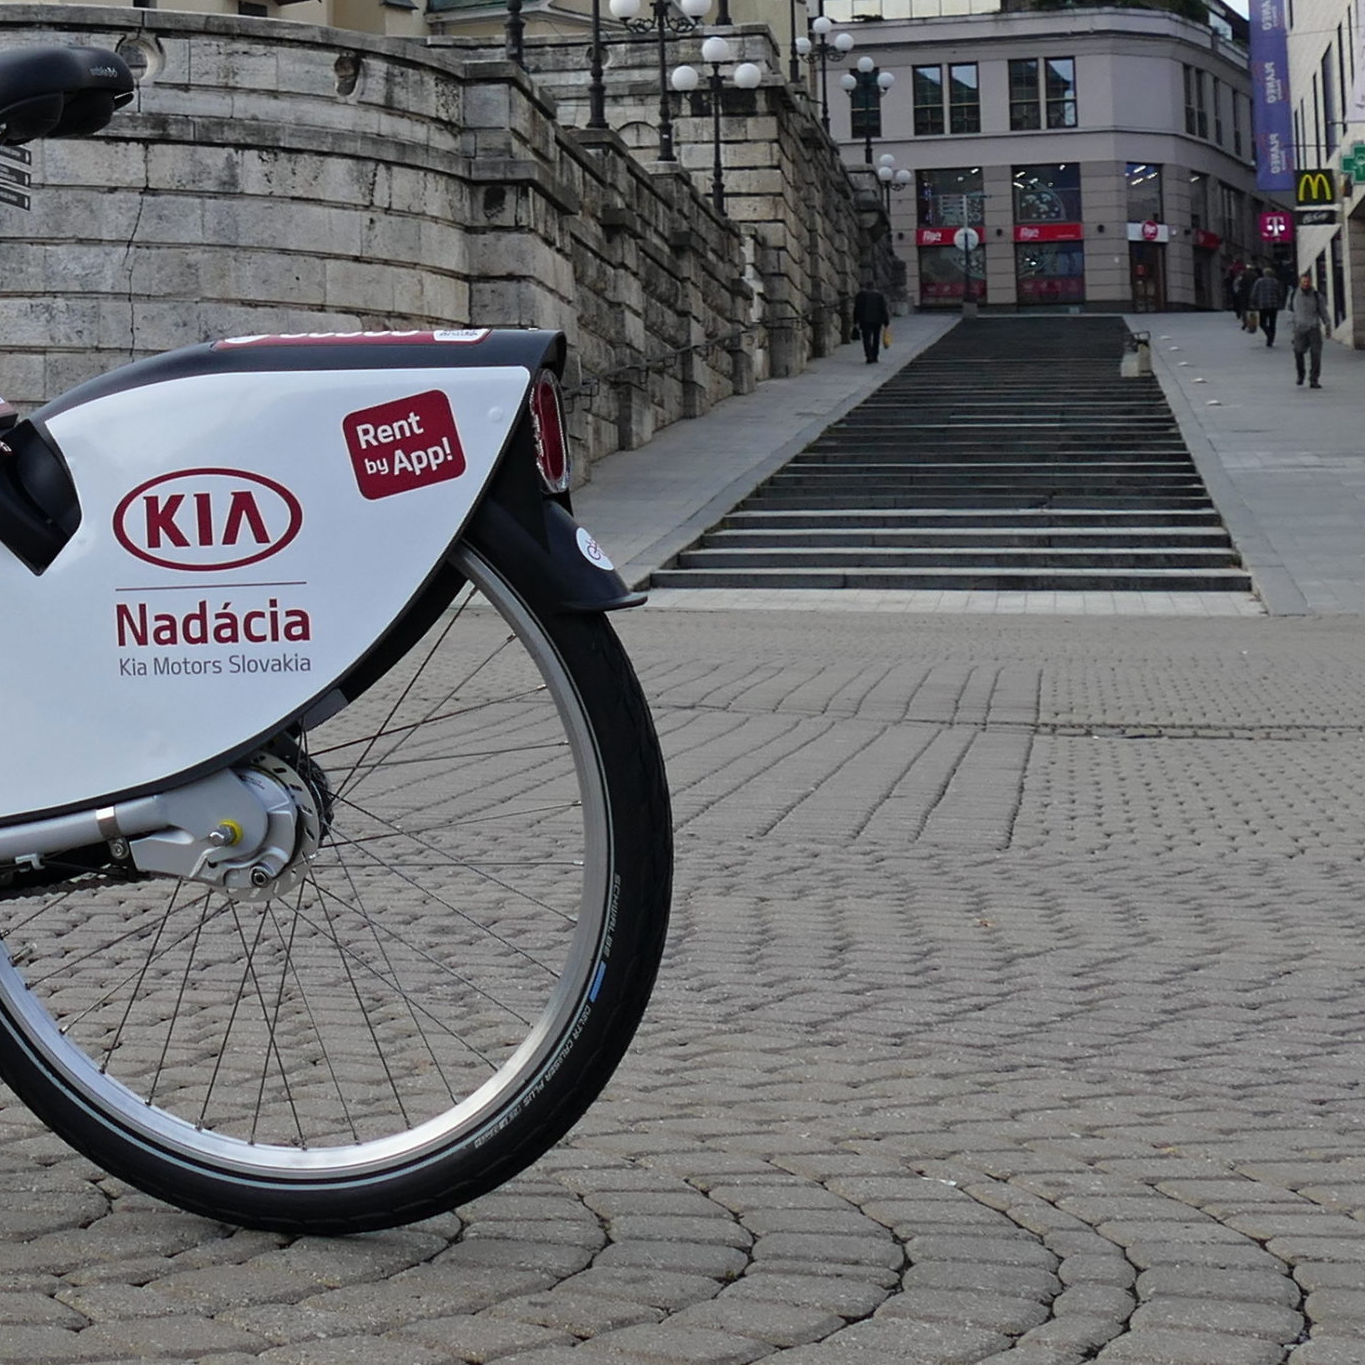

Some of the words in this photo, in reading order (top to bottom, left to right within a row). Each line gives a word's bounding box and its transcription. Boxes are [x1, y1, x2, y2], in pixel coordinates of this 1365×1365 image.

[356, 412, 424, 449] Rent
[364, 457, 389, 475] by
[393, 436, 453, 476] App!
[142, 491, 271, 549] KIA
[116, 598, 311, 647] Nadácia
[119, 657, 148, 677] Kia
[153, 656, 223, 676] Motors
[228, 652, 312, 674] Slovakia
[605, 873, 622, 959] SCHWALBE
